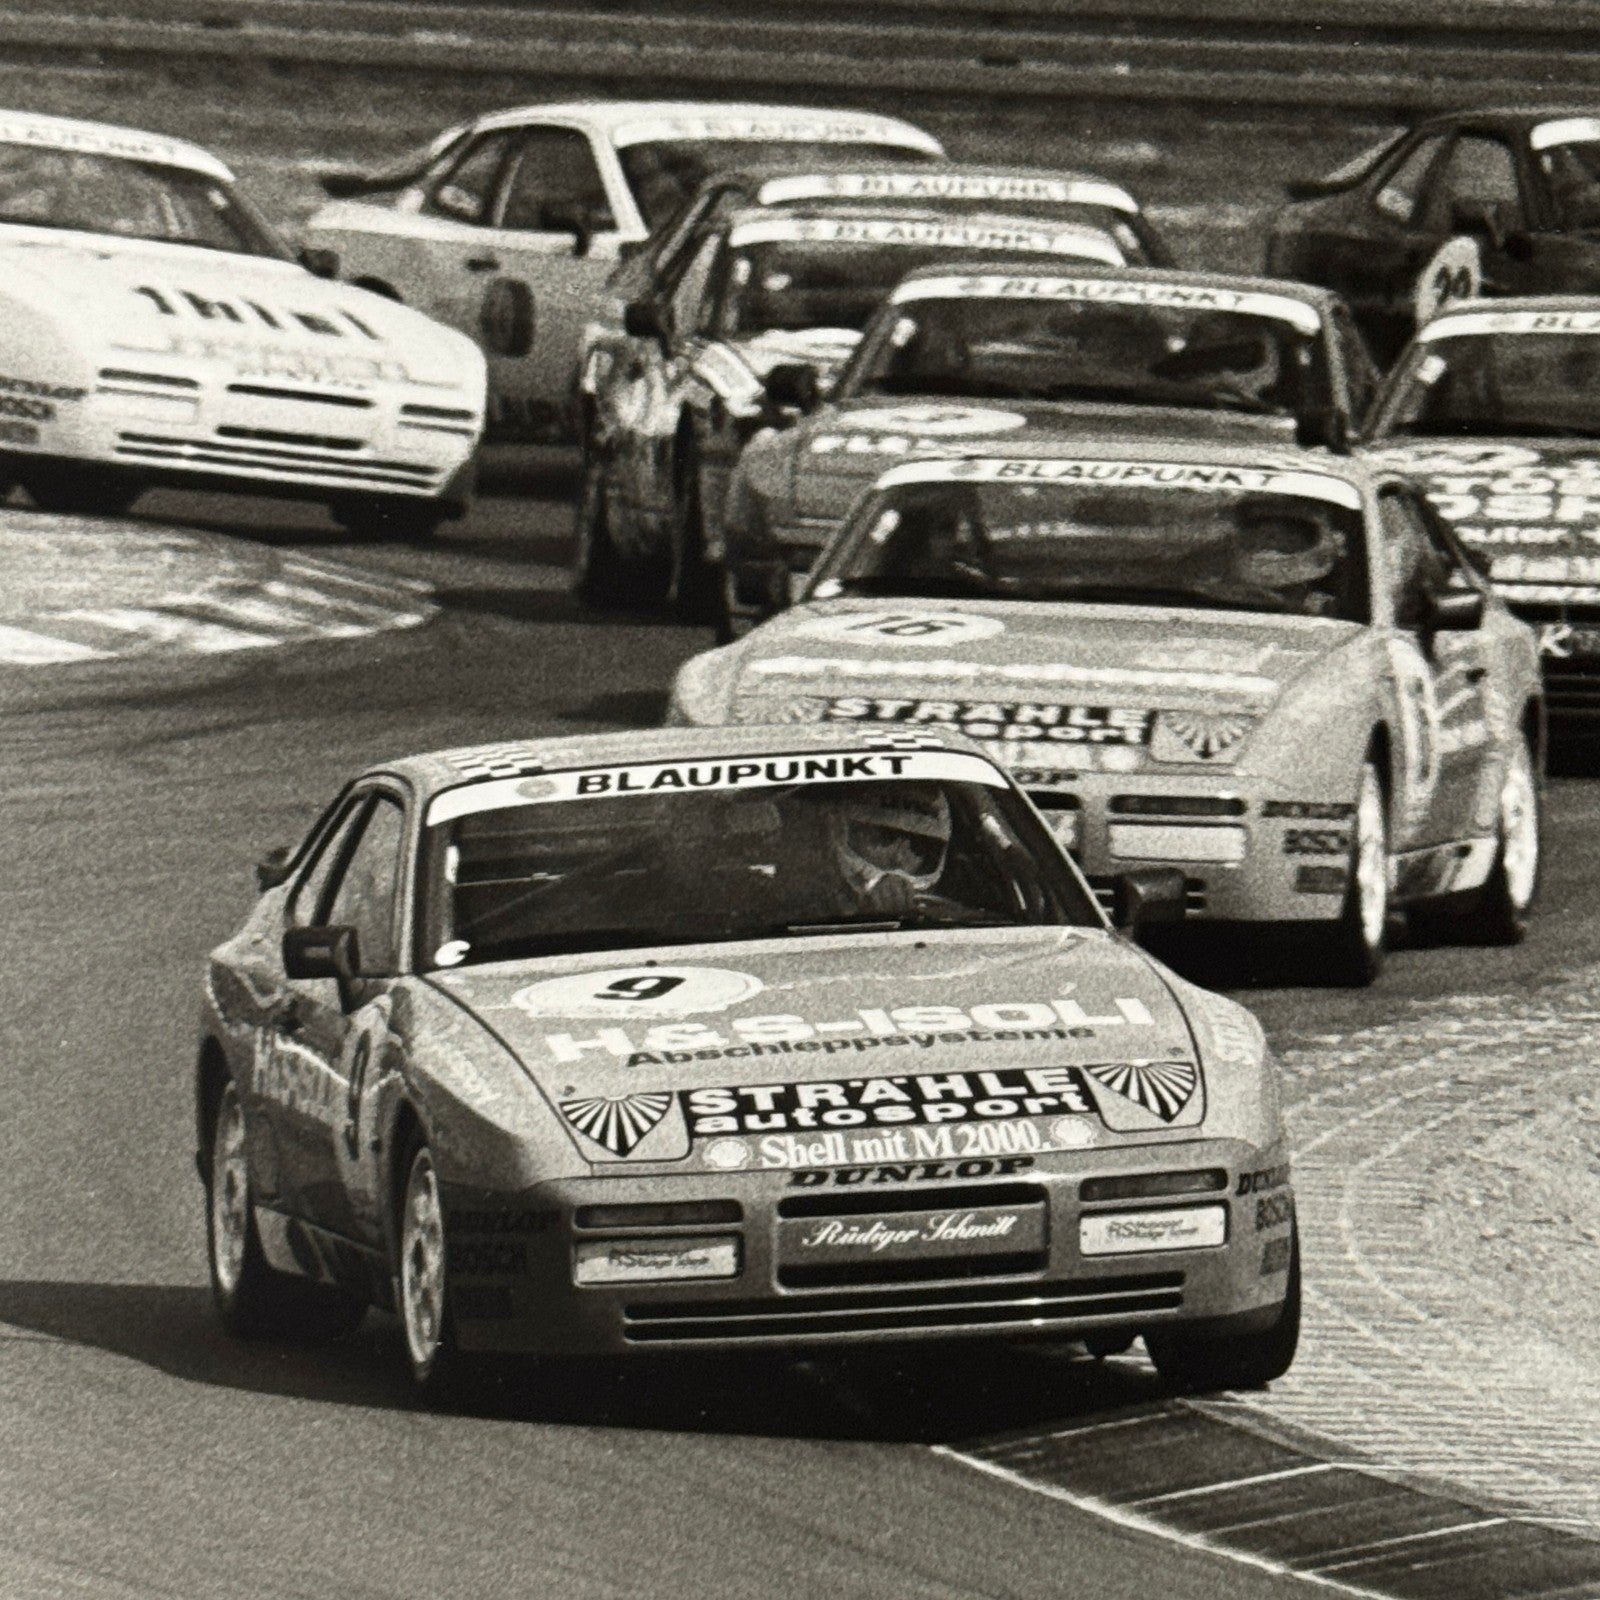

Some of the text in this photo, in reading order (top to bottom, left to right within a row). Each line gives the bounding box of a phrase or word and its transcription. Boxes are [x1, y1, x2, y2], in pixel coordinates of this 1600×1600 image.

[997, 462, 1277, 487] BLAUPUNKT
[576, 754, 913, 796] BLAUPUNKT
[594, 976, 686, 1001] 9
[627, 1026, 1097, 1067] Abschleppsysteme
[689, 1067, 1081, 1115] STRÄHLE
[694, 1092, 1090, 1134] autosport
[760, 1120, 1052, 1169] Shell mit M 2000.
[786, 1156, 1036, 1187] DUNLOP
[802, 1213, 1018, 1252] Rüdiger Schmitt
